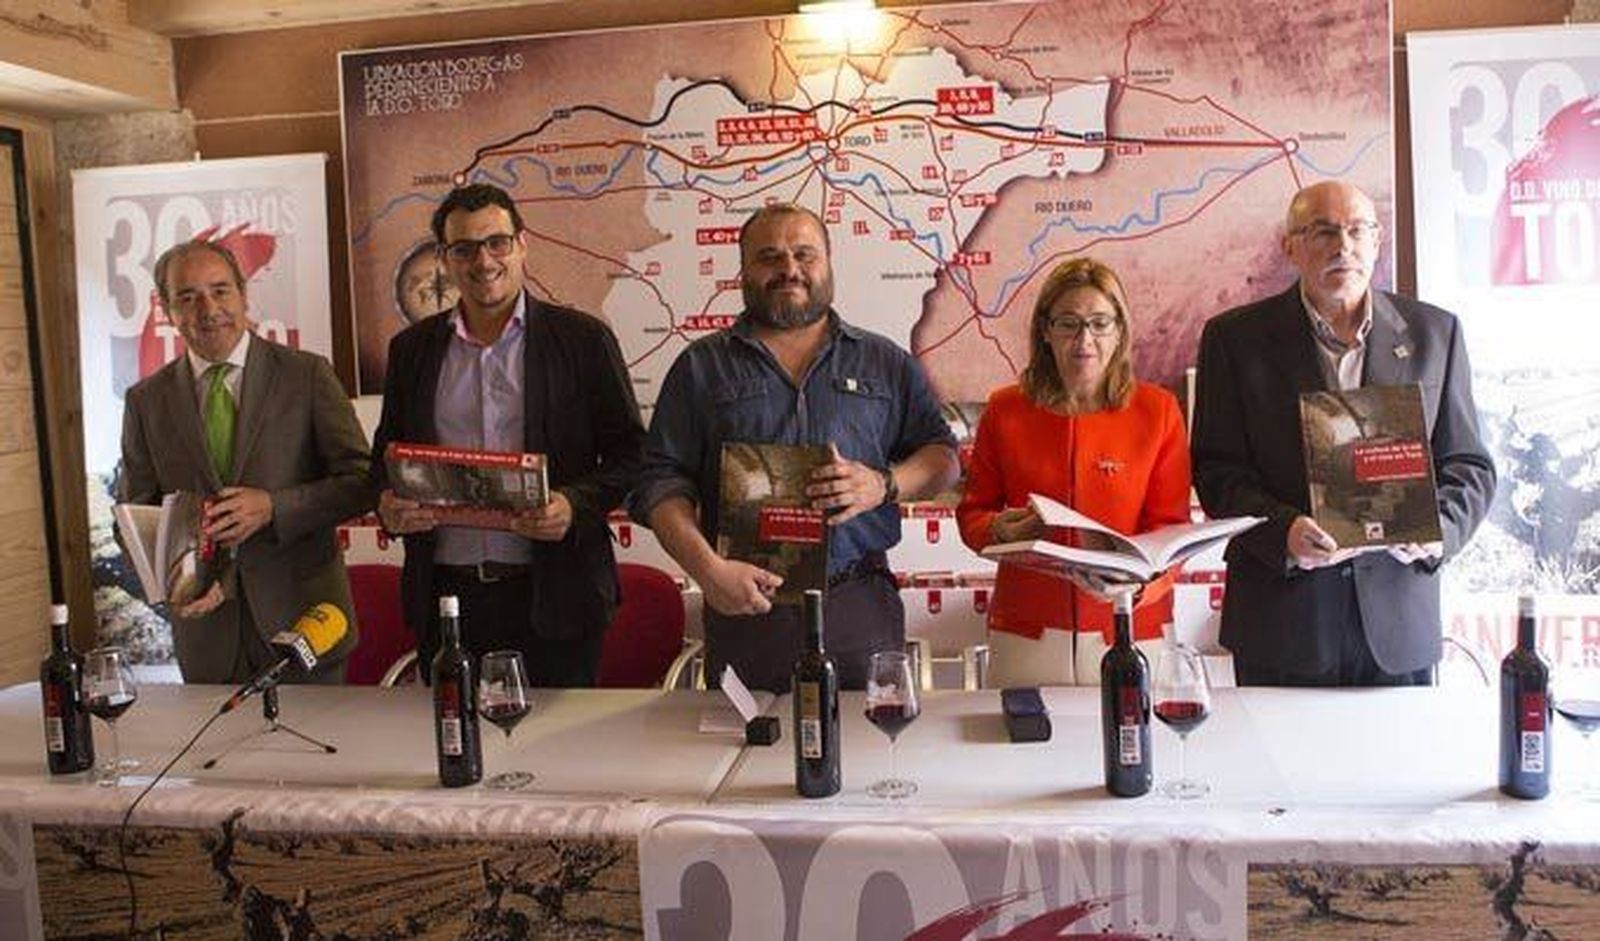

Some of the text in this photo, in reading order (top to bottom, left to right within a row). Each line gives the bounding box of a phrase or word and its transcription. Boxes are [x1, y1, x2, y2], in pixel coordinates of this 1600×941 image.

[447, 54, 524, 73] BODEGAS
[421, 94, 463, 111] TORO
[844, 135, 871, 147] TORO
[1055, 198, 1093, 213] DUERO
[1524, 734, 1541, 760] TORO
